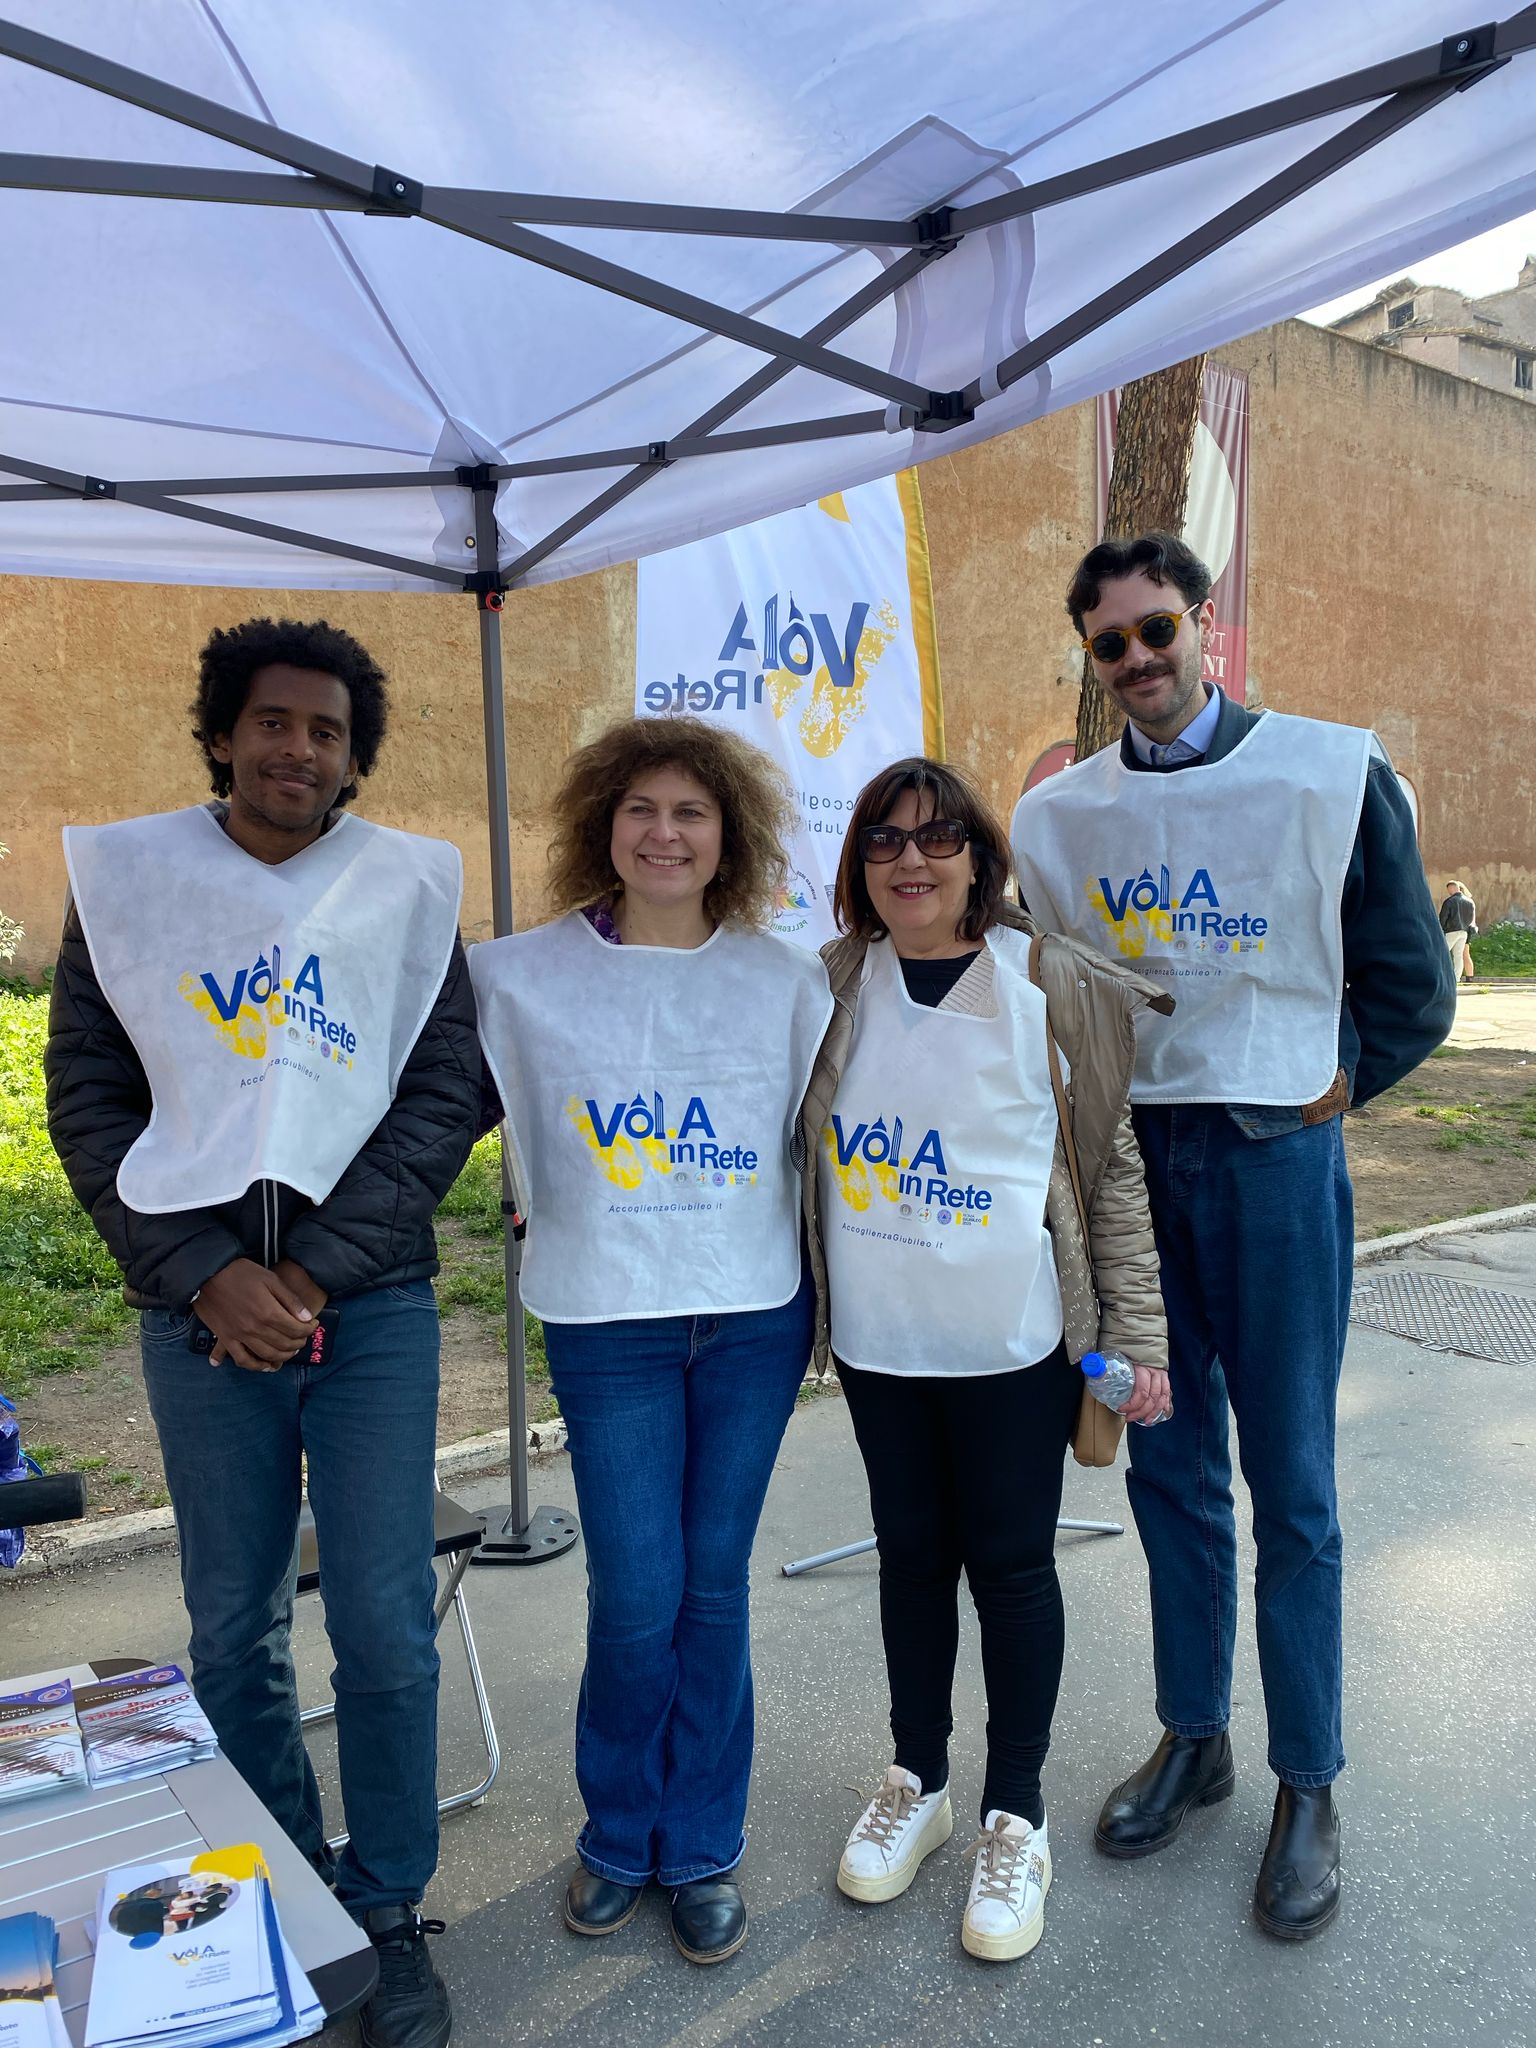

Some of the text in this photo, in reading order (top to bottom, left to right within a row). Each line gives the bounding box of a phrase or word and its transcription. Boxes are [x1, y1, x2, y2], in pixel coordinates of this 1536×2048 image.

[1172, 912, 1268, 937] in Rete
[284, 994, 357, 1054] in Rete
[669, 1142, 758, 1170] in Rete
[899, 1173, 992, 1211] in Rete
